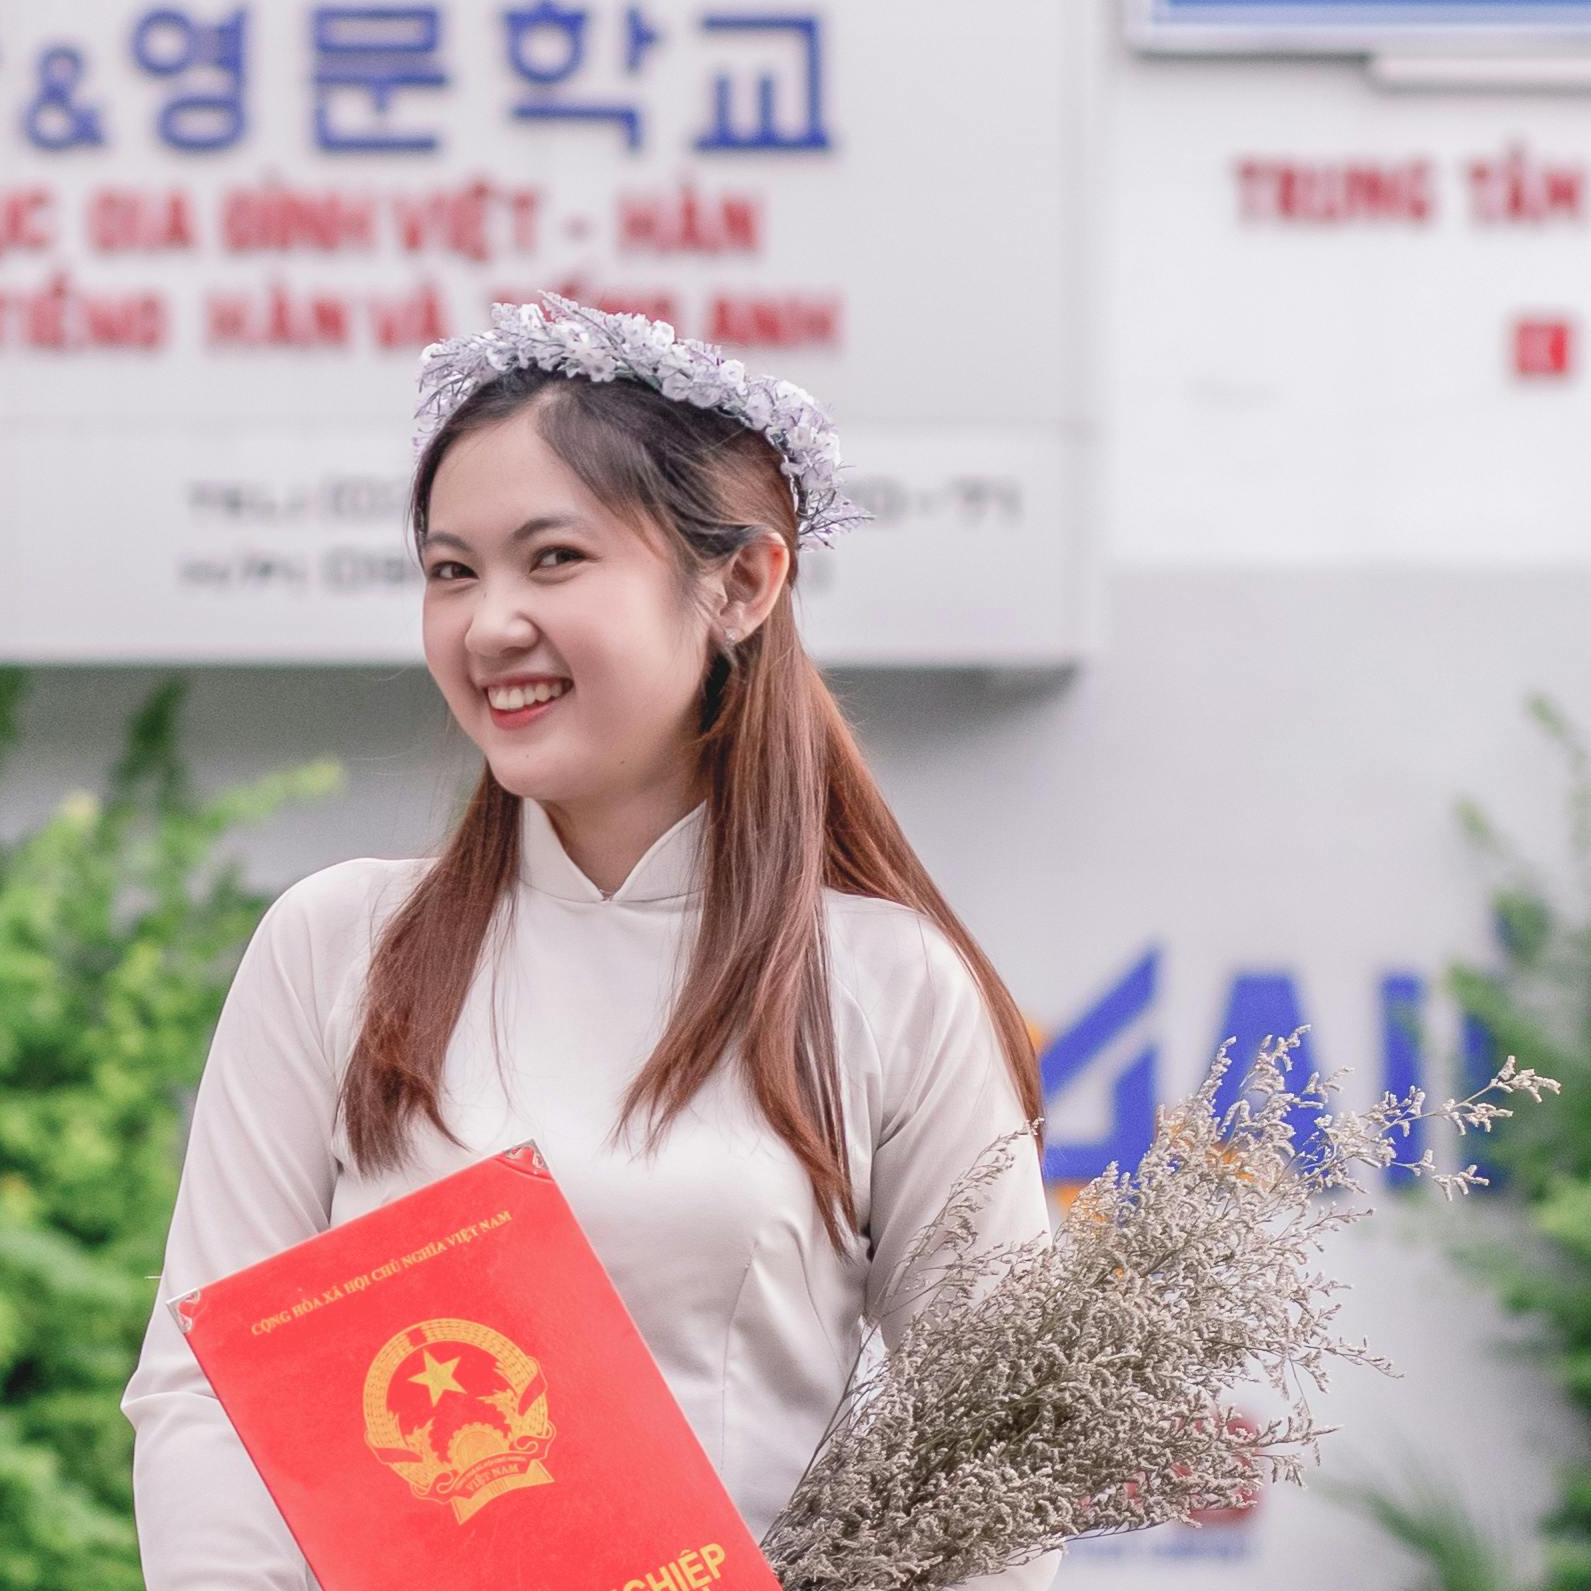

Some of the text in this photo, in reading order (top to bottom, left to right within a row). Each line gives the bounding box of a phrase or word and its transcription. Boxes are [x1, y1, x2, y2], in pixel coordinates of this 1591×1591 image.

[251, 1310, 292, 1336] CỘNG
[445, 1225, 480, 1247] VIỆT
[479, 1210, 513, 1233] NAM
